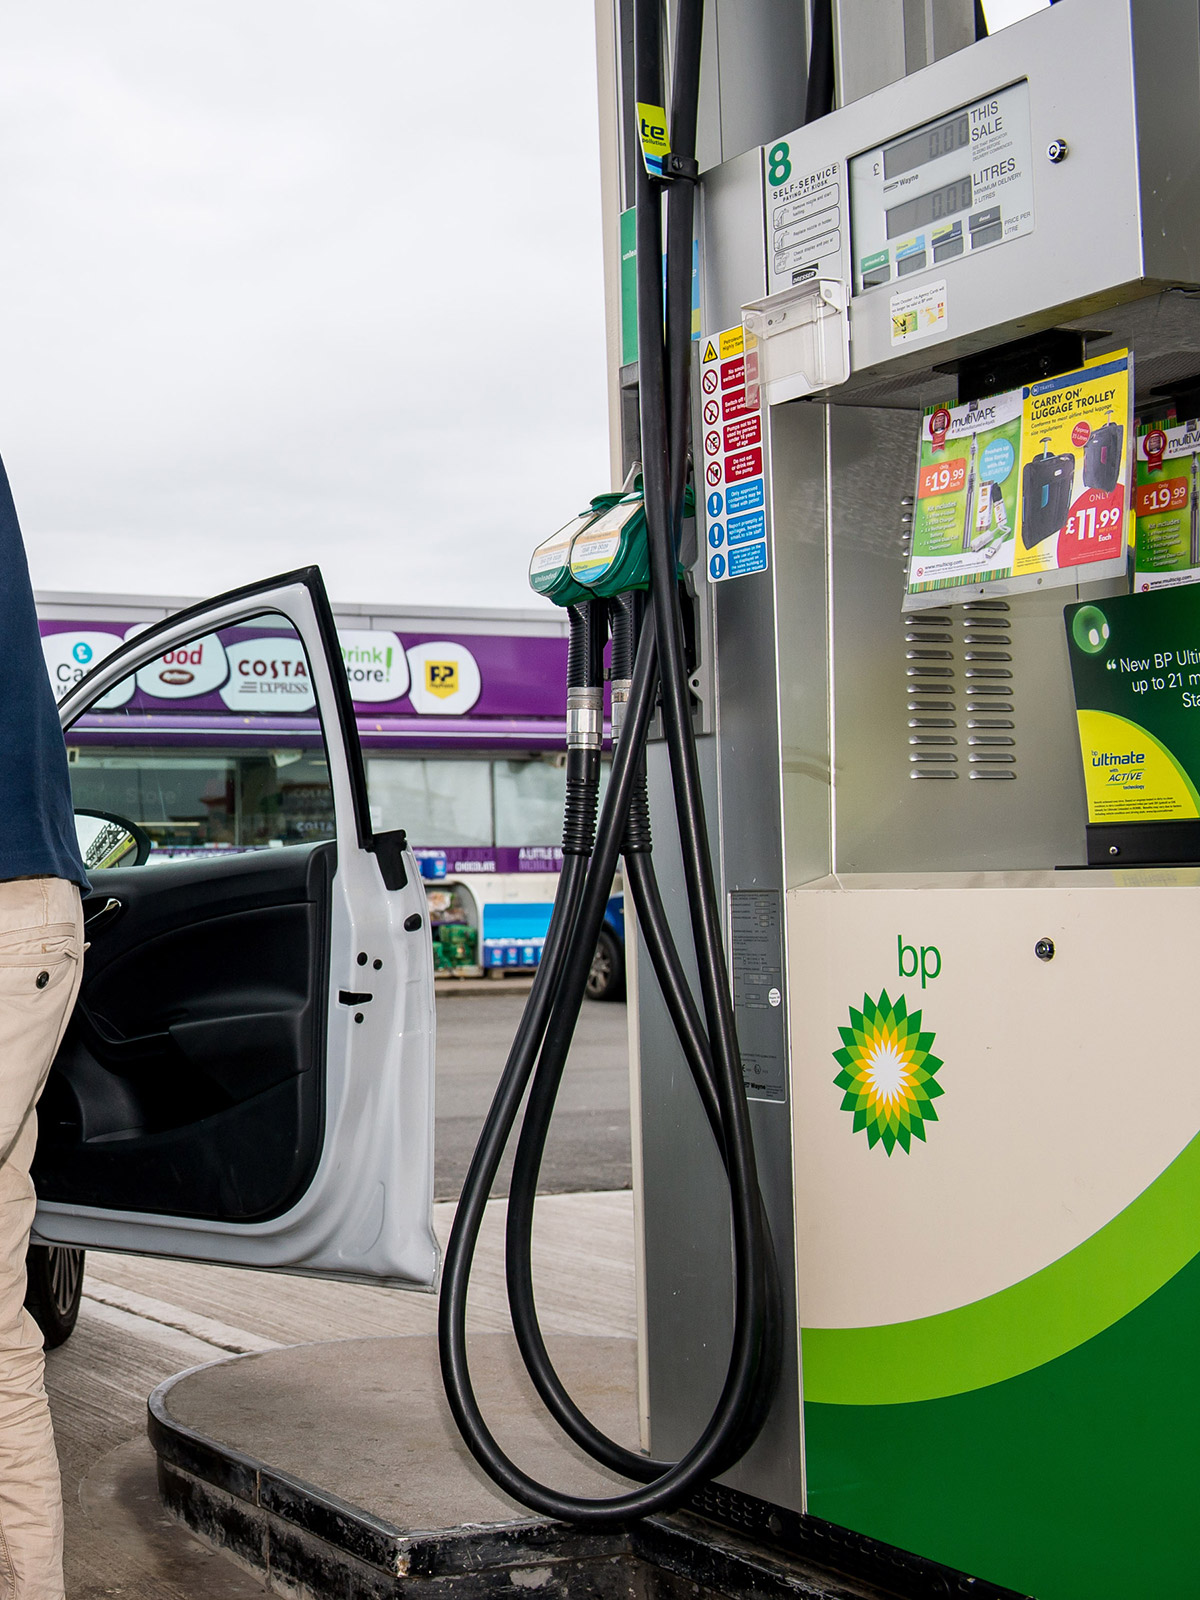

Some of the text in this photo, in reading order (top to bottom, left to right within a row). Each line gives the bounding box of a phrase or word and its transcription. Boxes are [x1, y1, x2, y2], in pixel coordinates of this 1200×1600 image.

[970, 100, 999, 123] THIS
[971, 116, 1003, 142] SALE
[642, 137, 667, 147] pollution
[768, 141, 792, 187] 8
[873, 162, 880, 177] £
[973, 157, 1016, 186] LITRES
[773, 165, 837, 200] SELF-SERVICE
[899, 174, 919, 187] Wayne
[974, 171, 1022, 196] MINIMUM DELIVERY
[783, 190, 802, 202] PAYING
[811, 180, 828, 190] KIOSK
[978, 191, 996, 203] LITRES
[1004, 211, 1031, 226] PRICE PER
[1004, 225, 1019, 235] LITRE
[623, 250, 637, 261] unlea
[1031, 389, 1116, 421] LUGGAGE TROLLEY
[1031, 420, 1051, 429] Conforms
[1095, 404, 1112, 413] luggage
[925, 468, 964, 492] £19.99
[1089, 492, 1110, 502] ONLY
[1143, 487, 1186, 510] £19.99
[936, 502, 957, 510] includes
[1065, 507, 1120, 541] £11.99
[1098, 534, 1112, 542] Each
[162, 643, 203, 665] ood
[1154, 653, 1173, 669] BP
[1176, 649, 1200, 667] Ulti
[238, 660, 307, 679] COSTA
[346, 666, 384, 682] tore
[260, 682, 309, 694] EXPRESS
[1131, 679, 1148, 694] up
[1151, 677, 1165, 690] to
[1168, 673, 1183, 688] 21
[1182, 692, 1200, 708] Sta
[1092, 751, 1145, 767] ultimate
[1108, 772, 1144, 782] ACTIVE
[455, 861, 496, 872] CHOCOLATE
[897, 934, 942, 989] bp
[751, 1082, 767, 1091] Wayne
